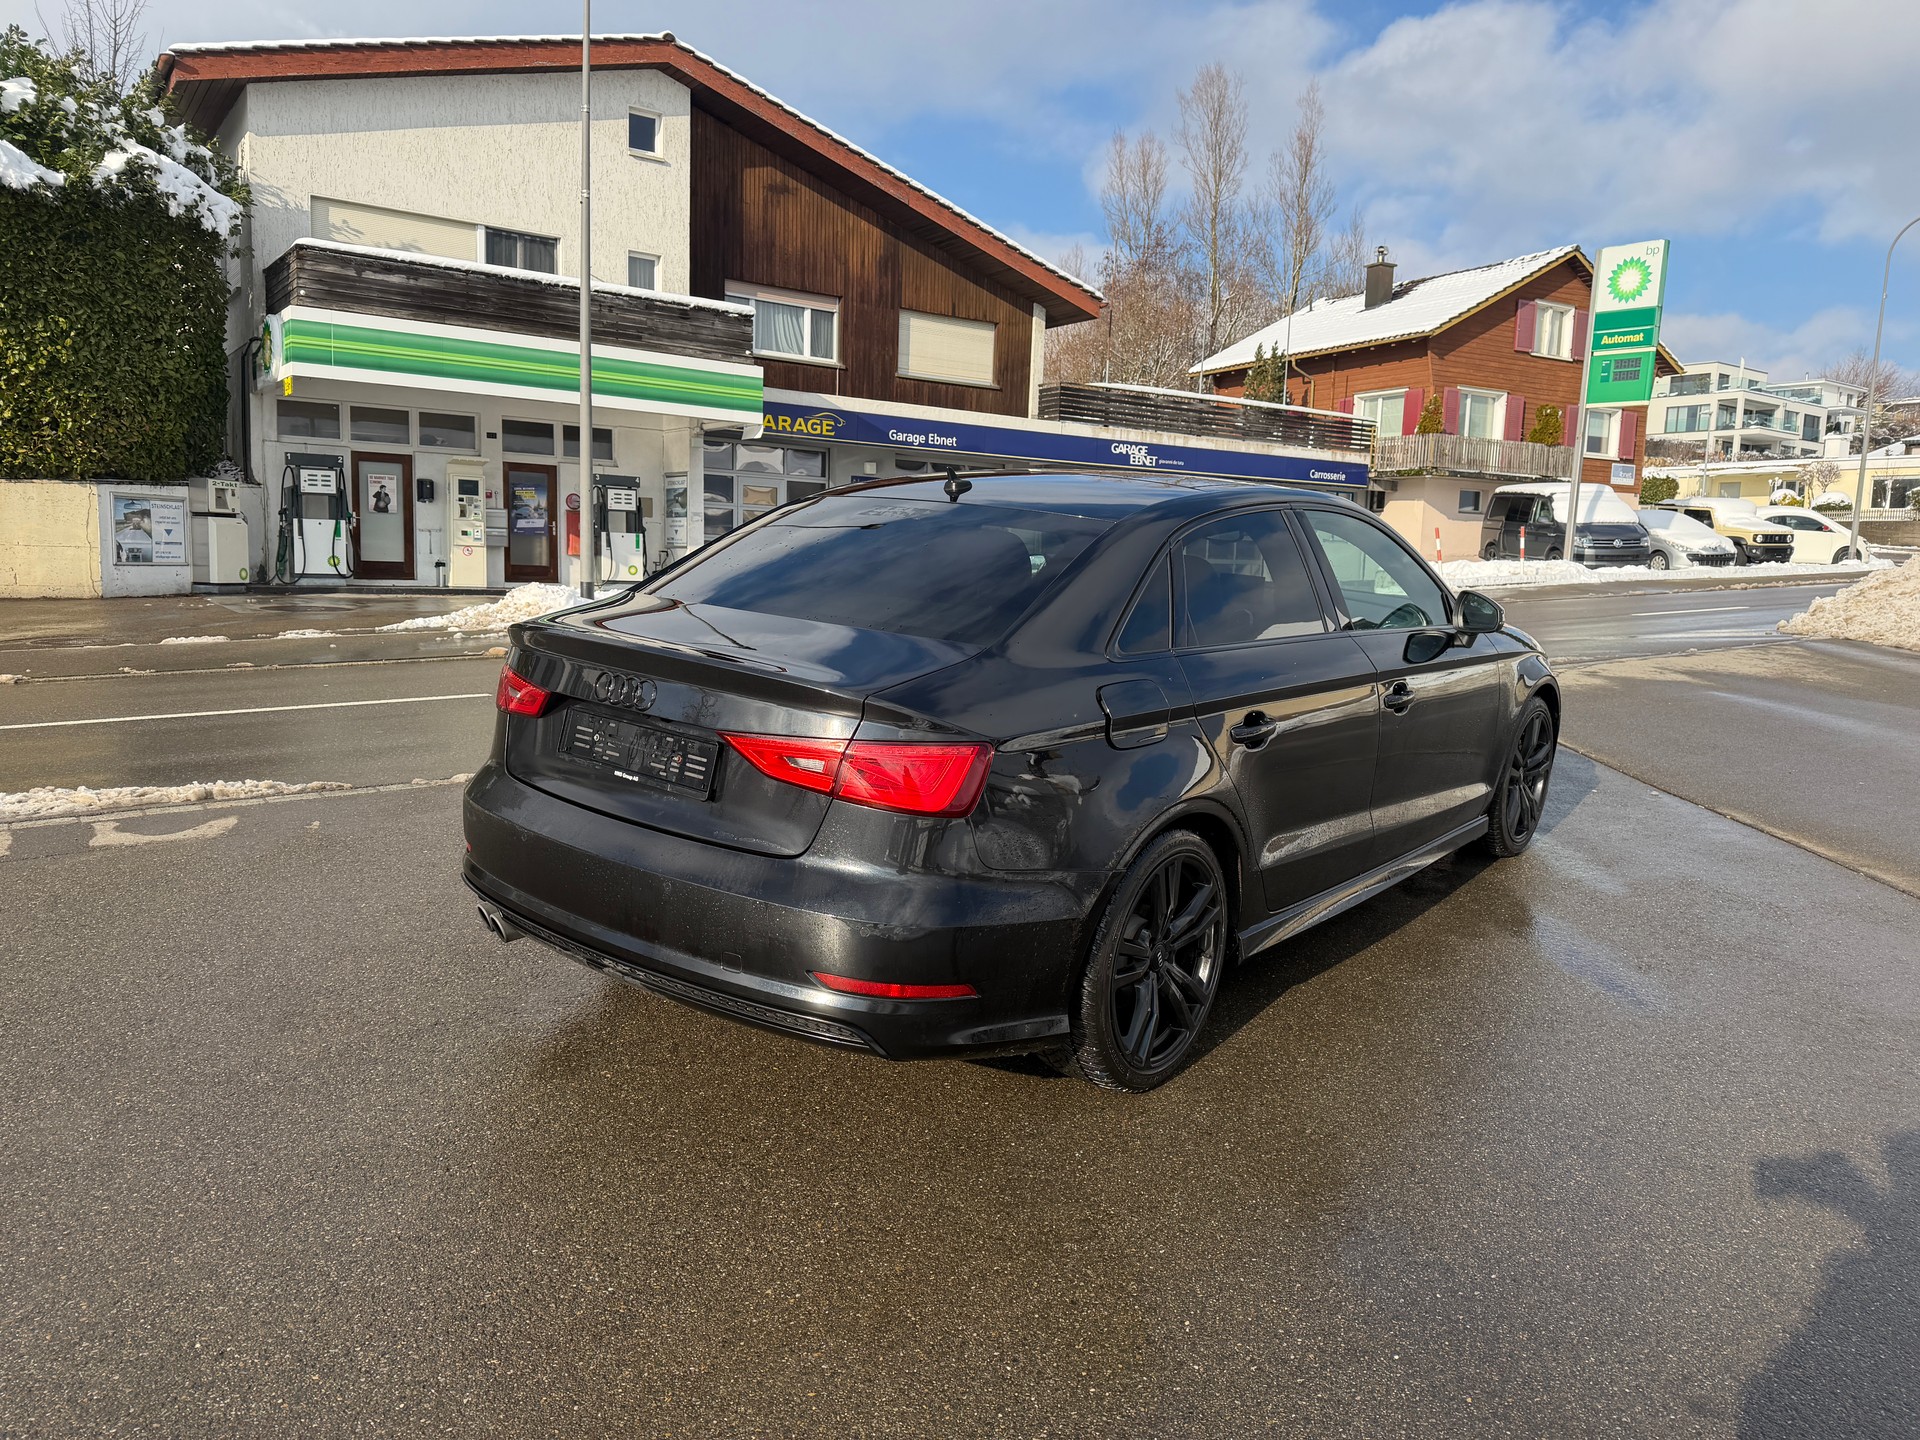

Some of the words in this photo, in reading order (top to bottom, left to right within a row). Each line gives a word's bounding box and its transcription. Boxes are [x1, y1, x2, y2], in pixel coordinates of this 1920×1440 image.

[1646, 246, 1660, 256] bp
[1601, 332, 1644, 345] Automat
[763, 414, 835, 436] ARAGE
[888, 429, 926, 446] Garage
[928, 433, 957, 447] Ebnet
[1111, 443, 1148, 456] GARAGE
[1130, 454, 1158, 467] EBNET
[1309, 469, 1346, 482] Carrosserie
